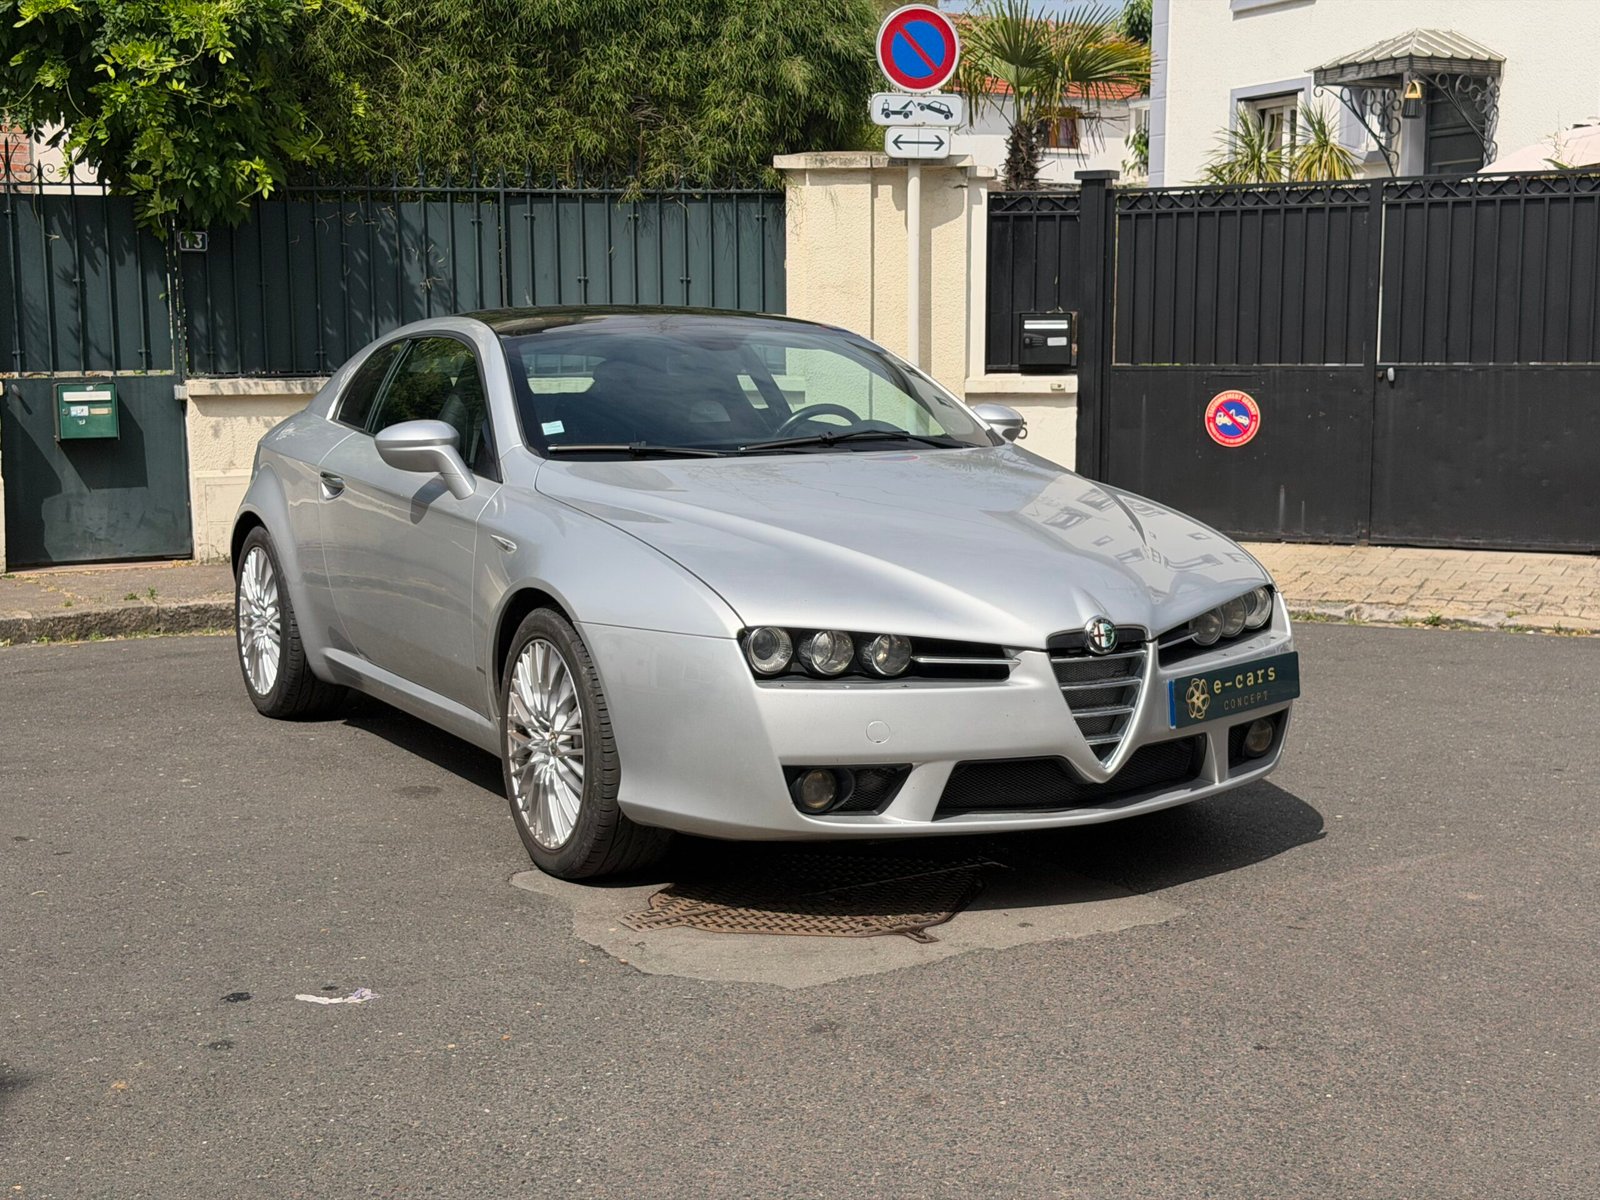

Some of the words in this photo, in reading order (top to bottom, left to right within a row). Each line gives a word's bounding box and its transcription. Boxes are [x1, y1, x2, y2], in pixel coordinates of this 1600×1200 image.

[183, 234, 203, 249] 13
[1213, 666, 1276, 694] e-cars
[1223, 690, 1269, 711] CONCEPT
